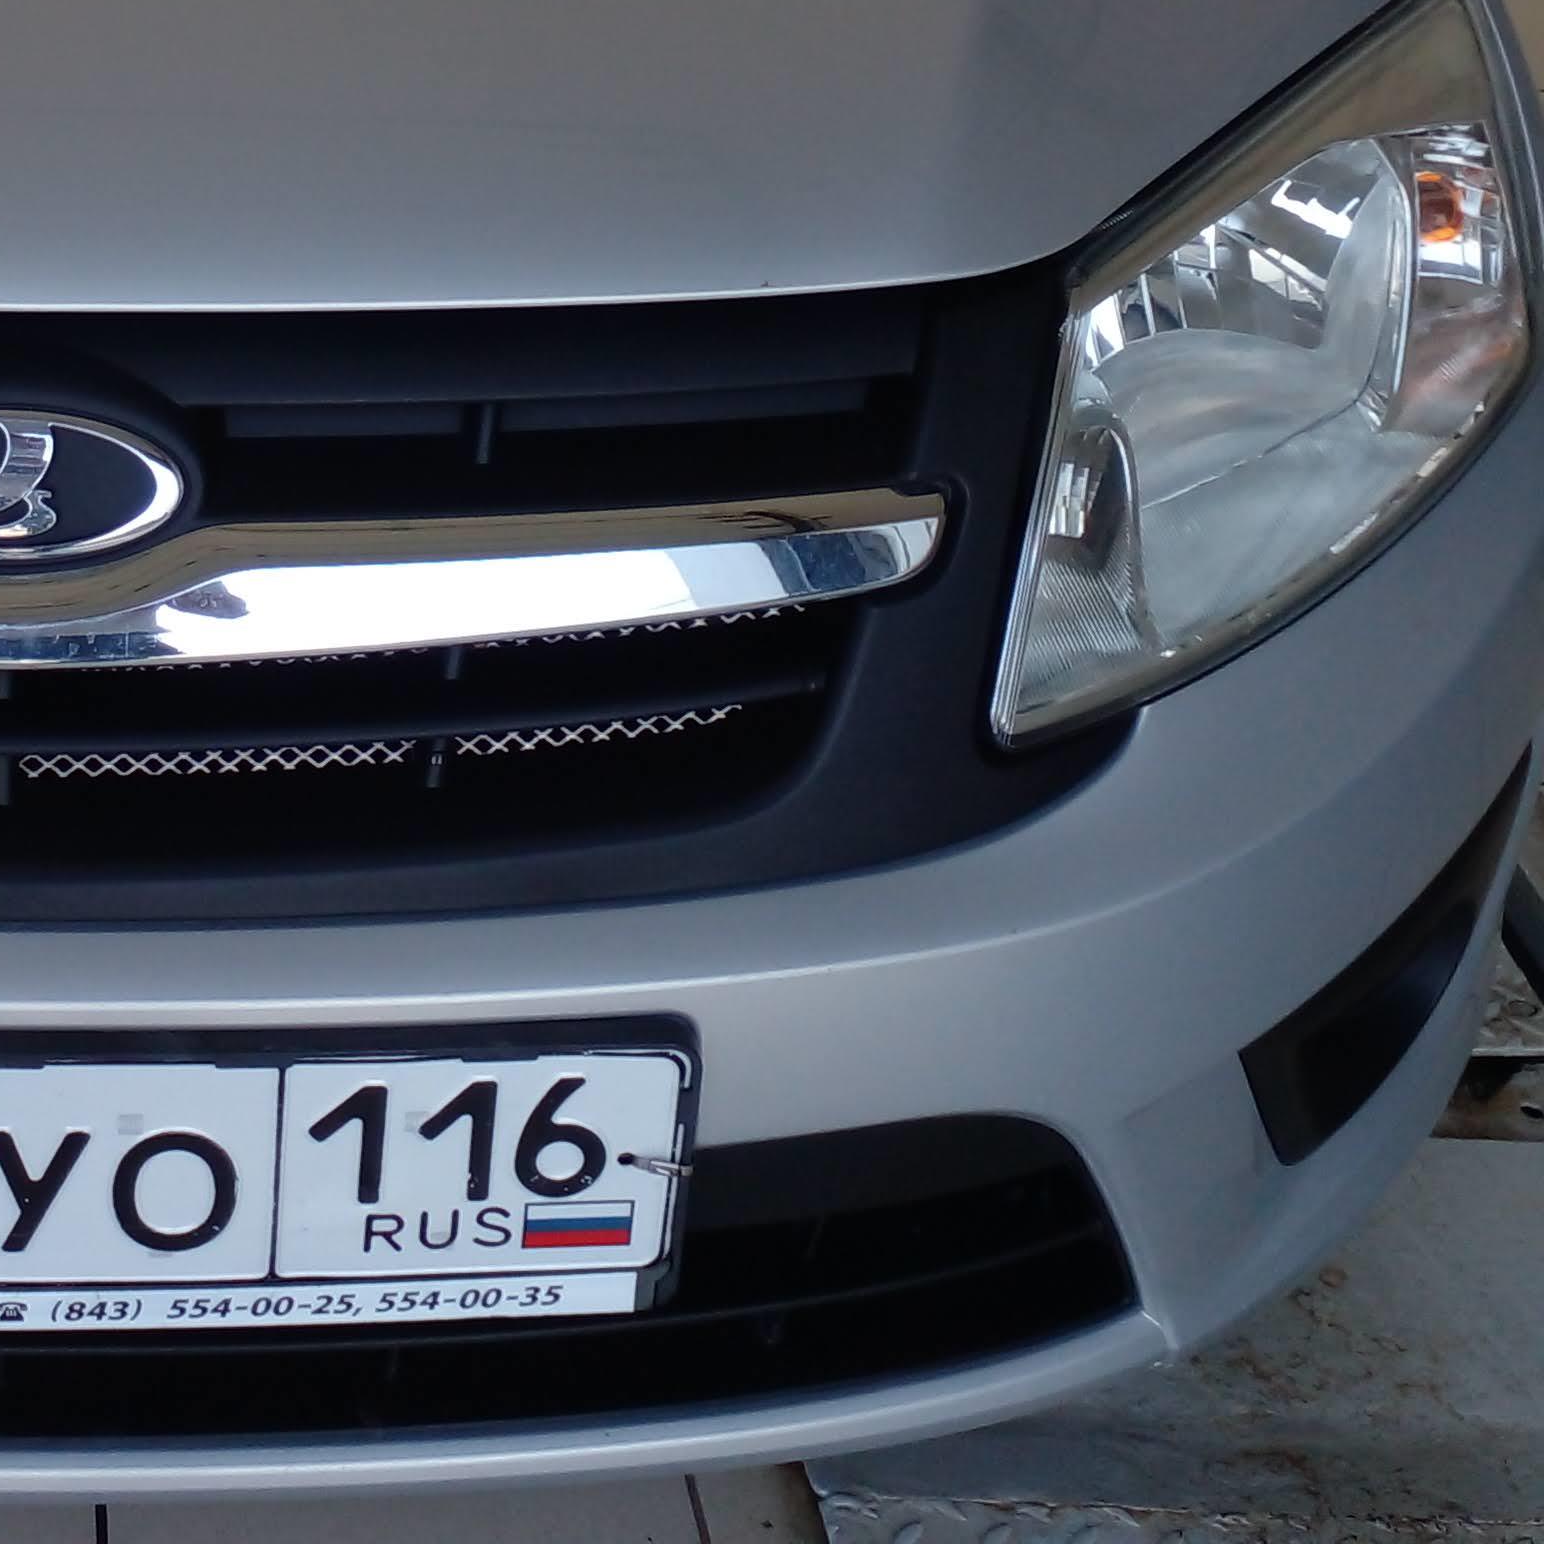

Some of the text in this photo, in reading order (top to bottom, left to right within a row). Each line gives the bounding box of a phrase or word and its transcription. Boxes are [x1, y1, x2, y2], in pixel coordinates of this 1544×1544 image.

[308, 1076, 608, 1205] 116
[363, 1206, 513, 1253] RUS
[51, 1298, 143, 1323] (843)
[166, 1293, 363, 1320] 554-00-25,
[375, 1285, 564, 1313] 554-00-35
